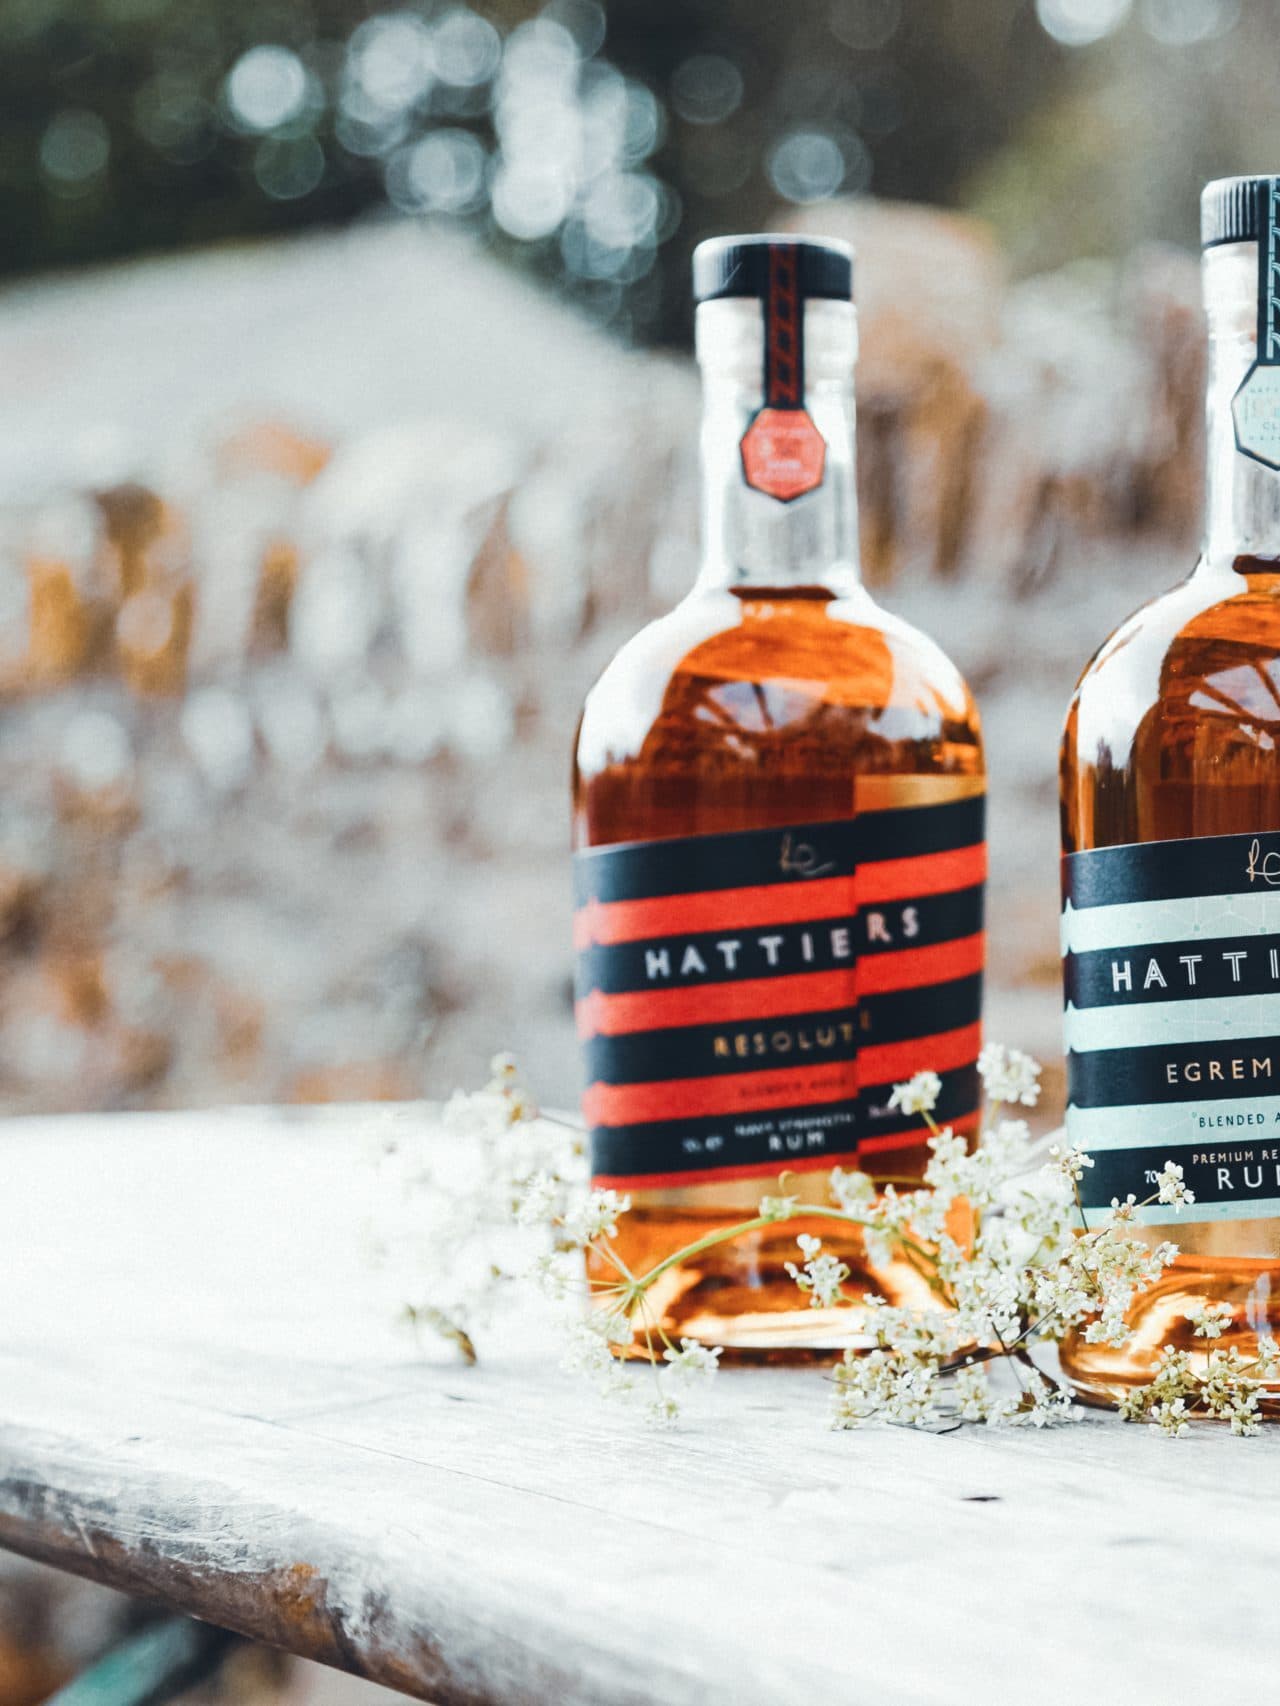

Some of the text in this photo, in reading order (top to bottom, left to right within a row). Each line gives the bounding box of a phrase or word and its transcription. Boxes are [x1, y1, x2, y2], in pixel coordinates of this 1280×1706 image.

[643, 906, 920, 980] HATTIERS
[1198, 1113, 1265, 1128] BLENDED
[768, 1131, 825, 1151] RUM
[1192, 1150, 1254, 1165] PREMIUM
